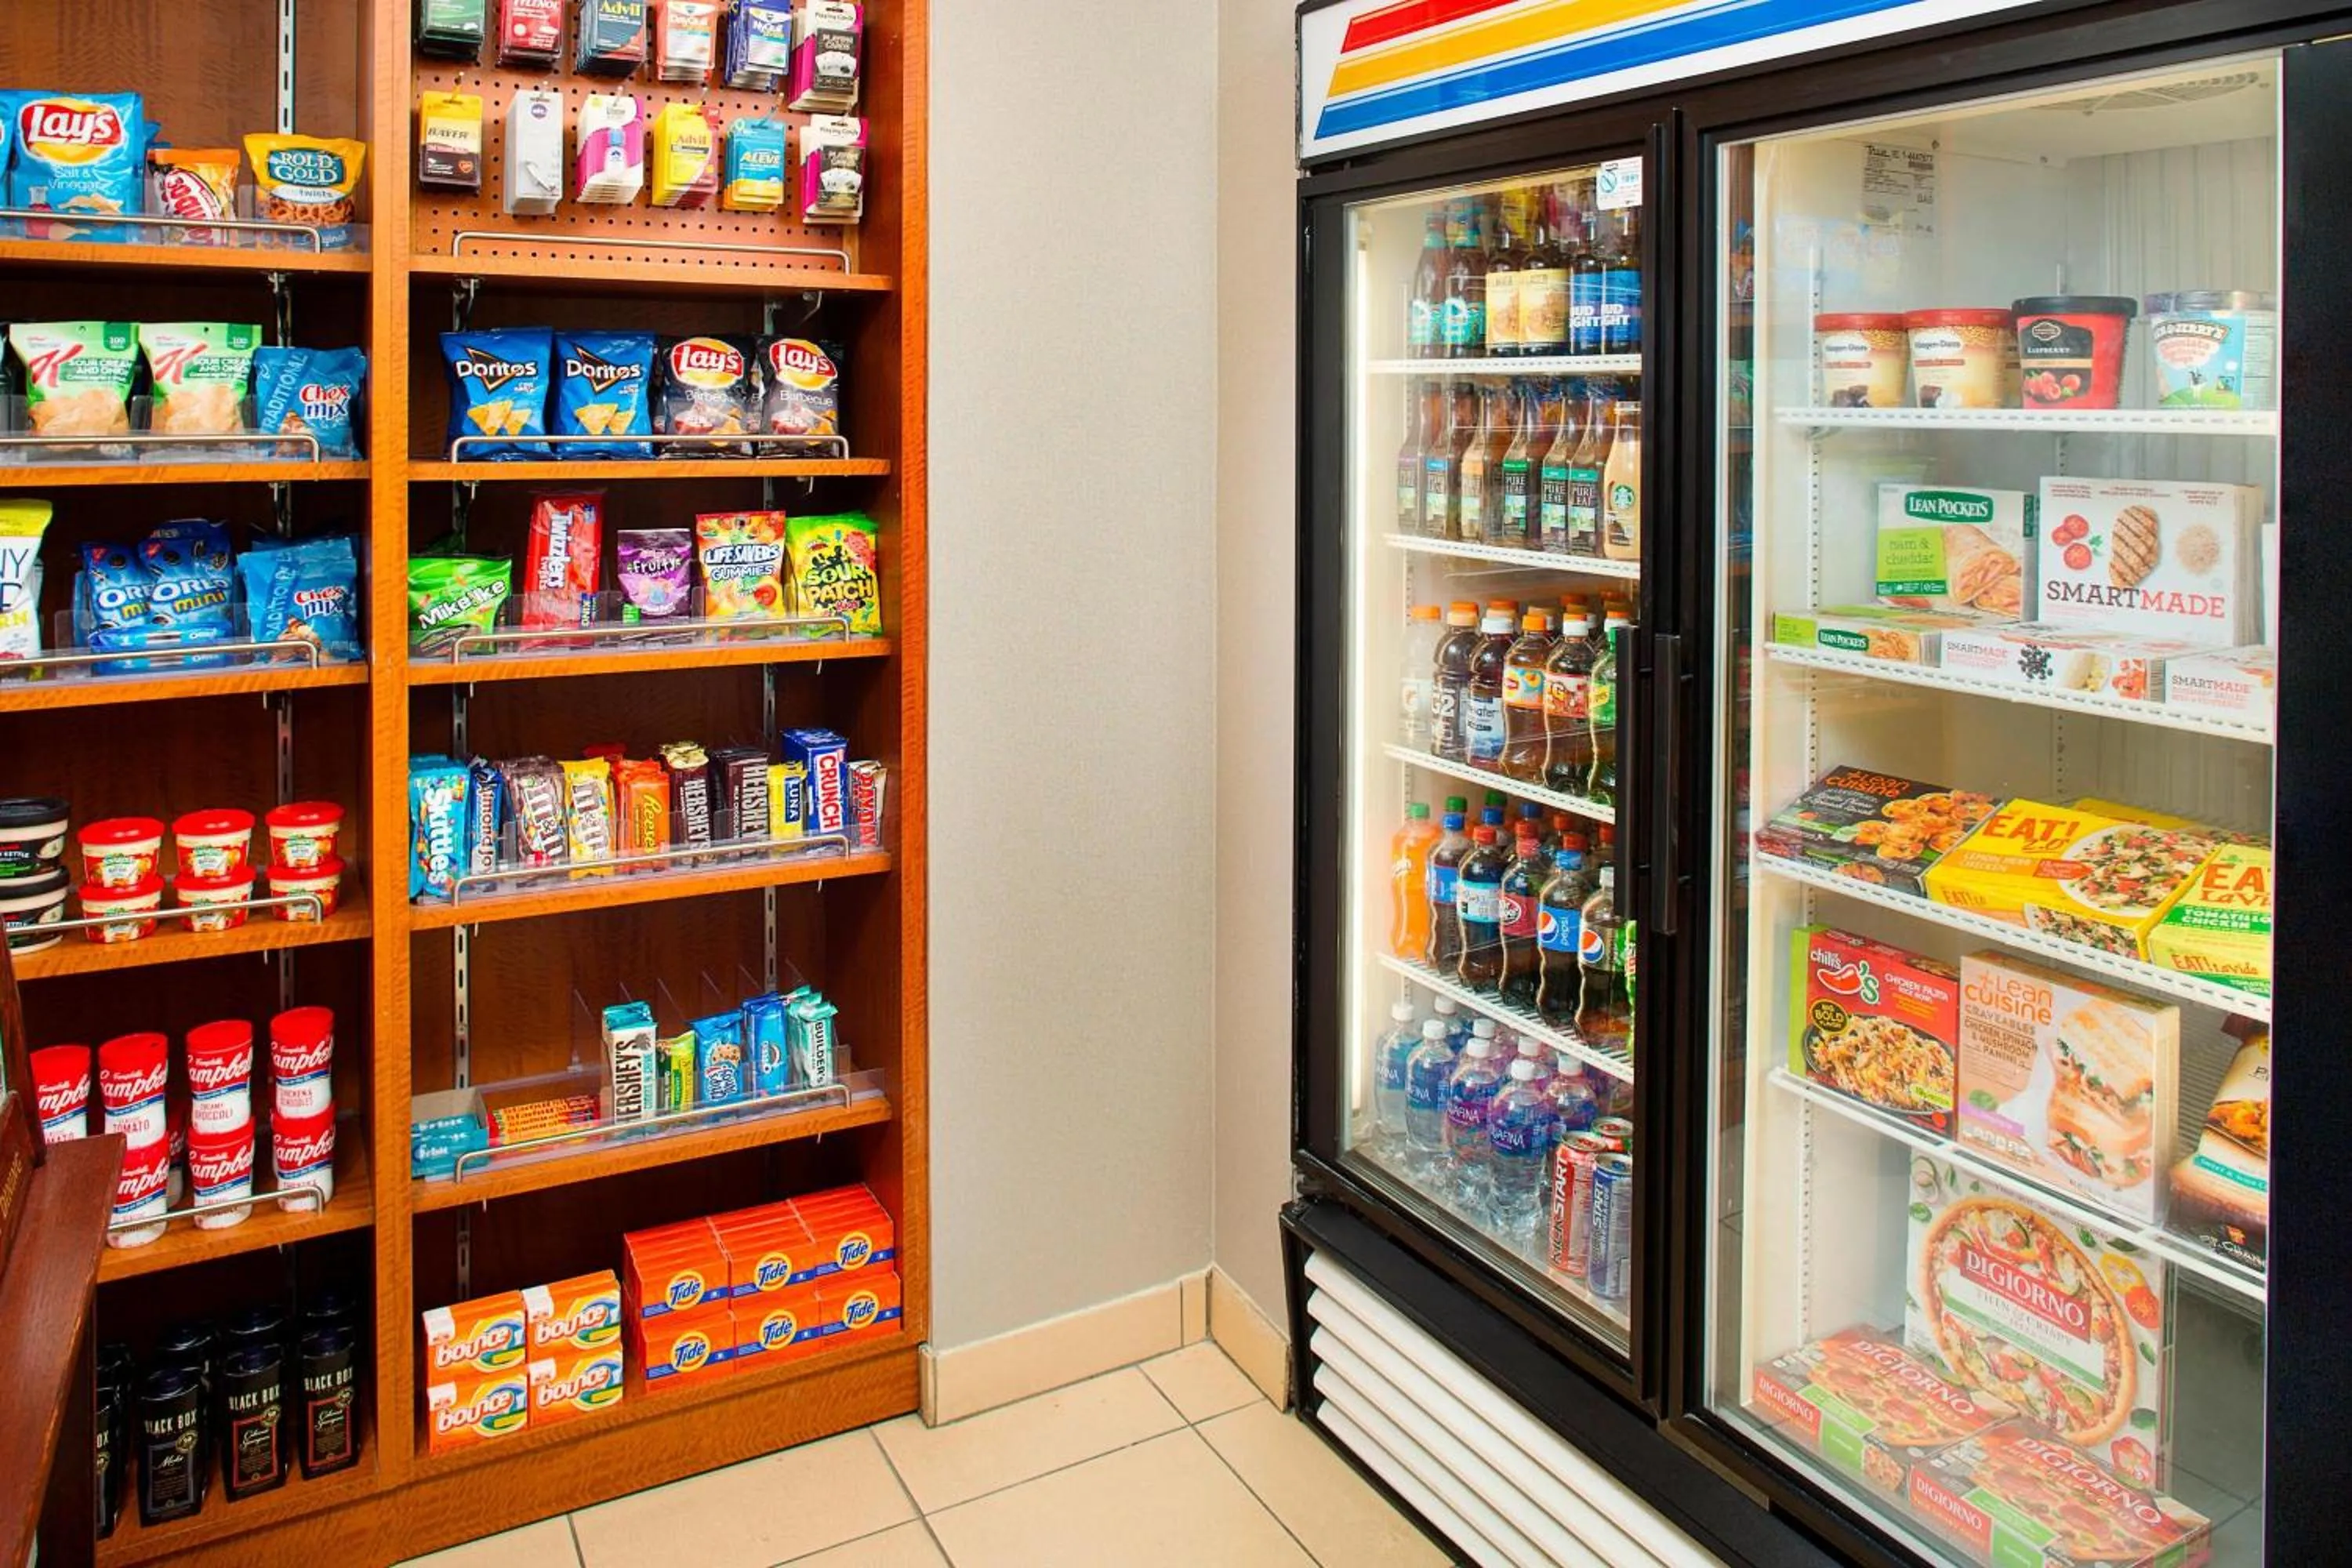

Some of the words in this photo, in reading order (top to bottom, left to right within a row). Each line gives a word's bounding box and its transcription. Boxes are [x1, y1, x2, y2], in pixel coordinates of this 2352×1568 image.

[53, 165, 82, 179] Salt
[280, 151, 336, 169] ROLD
[274, 165, 338, 183] GOLD
[456, 359, 538, 378] Doritos
[565, 359, 642, 379] Doritos
[299, 383, 350, 405] Chex
[1908, 495, 1938, 513] LEAN
[1938, 498, 1989, 518] POCKETS
[548, 510, 575, 589] Twizzlers
[710, 564, 773, 582] GUMMIES
[806, 564, 866, 585] SOUR
[152, 577, 230, 604] OREO
[172, 590, 226, 614] mini
[806, 580, 873, 602] PATCH
[2046, 579, 2226, 619] SMARTMADE
[419, 597, 472, 630] Mike
[2171, 674, 2252, 694] SMARTMADE
[787, 778, 800, 818] LUNA
[818, 754, 842, 829] CRUNCH
[858, 771, 878, 846] PAYDAY
[423, 787, 454, 885] Skittles
[1982, 815, 2082, 842] EAT!
[2201, 864, 2270, 892] EA
[1814, 1008, 1844, 1022] BOLD
[113, 1119, 150, 1133] TOMATO
[840, 1241, 869, 1263] Tide
[757, 1262, 788, 1285] Tide
[669, 1282, 701, 1305] Tide
[1966, 1250, 2085, 1328] DIGIORNO
[846, 1301, 876, 1323] Tide
[536, 1306, 607, 1344] bounce
[762, 1320, 793, 1344] Tide
[437, 1327, 510, 1367] bounce
[673, 1342, 706, 1367] Tide
[305, 1375, 332, 1392] BLACK
[539, 1367, 609, 1406] bounce
[1849, 1339, 1976, 1415] DIGIORNO
[228, 1392, 258, 1411] BLACK
[262, 1385, 281, 1403] BOX
[1759, 1377, 1815, 1423] DIGIORNO
[144, 1417, 173, 1435] BLACK
[178, 1409, 198, 1428] BOX
[437, 1392, 512, 1432] bounce
[96, 1430, 110, 1449] OX
[2014, 1436, 2162, 1526] DIGIORNO
[1916, 1477, 1983, 1531] DIGIORNO
